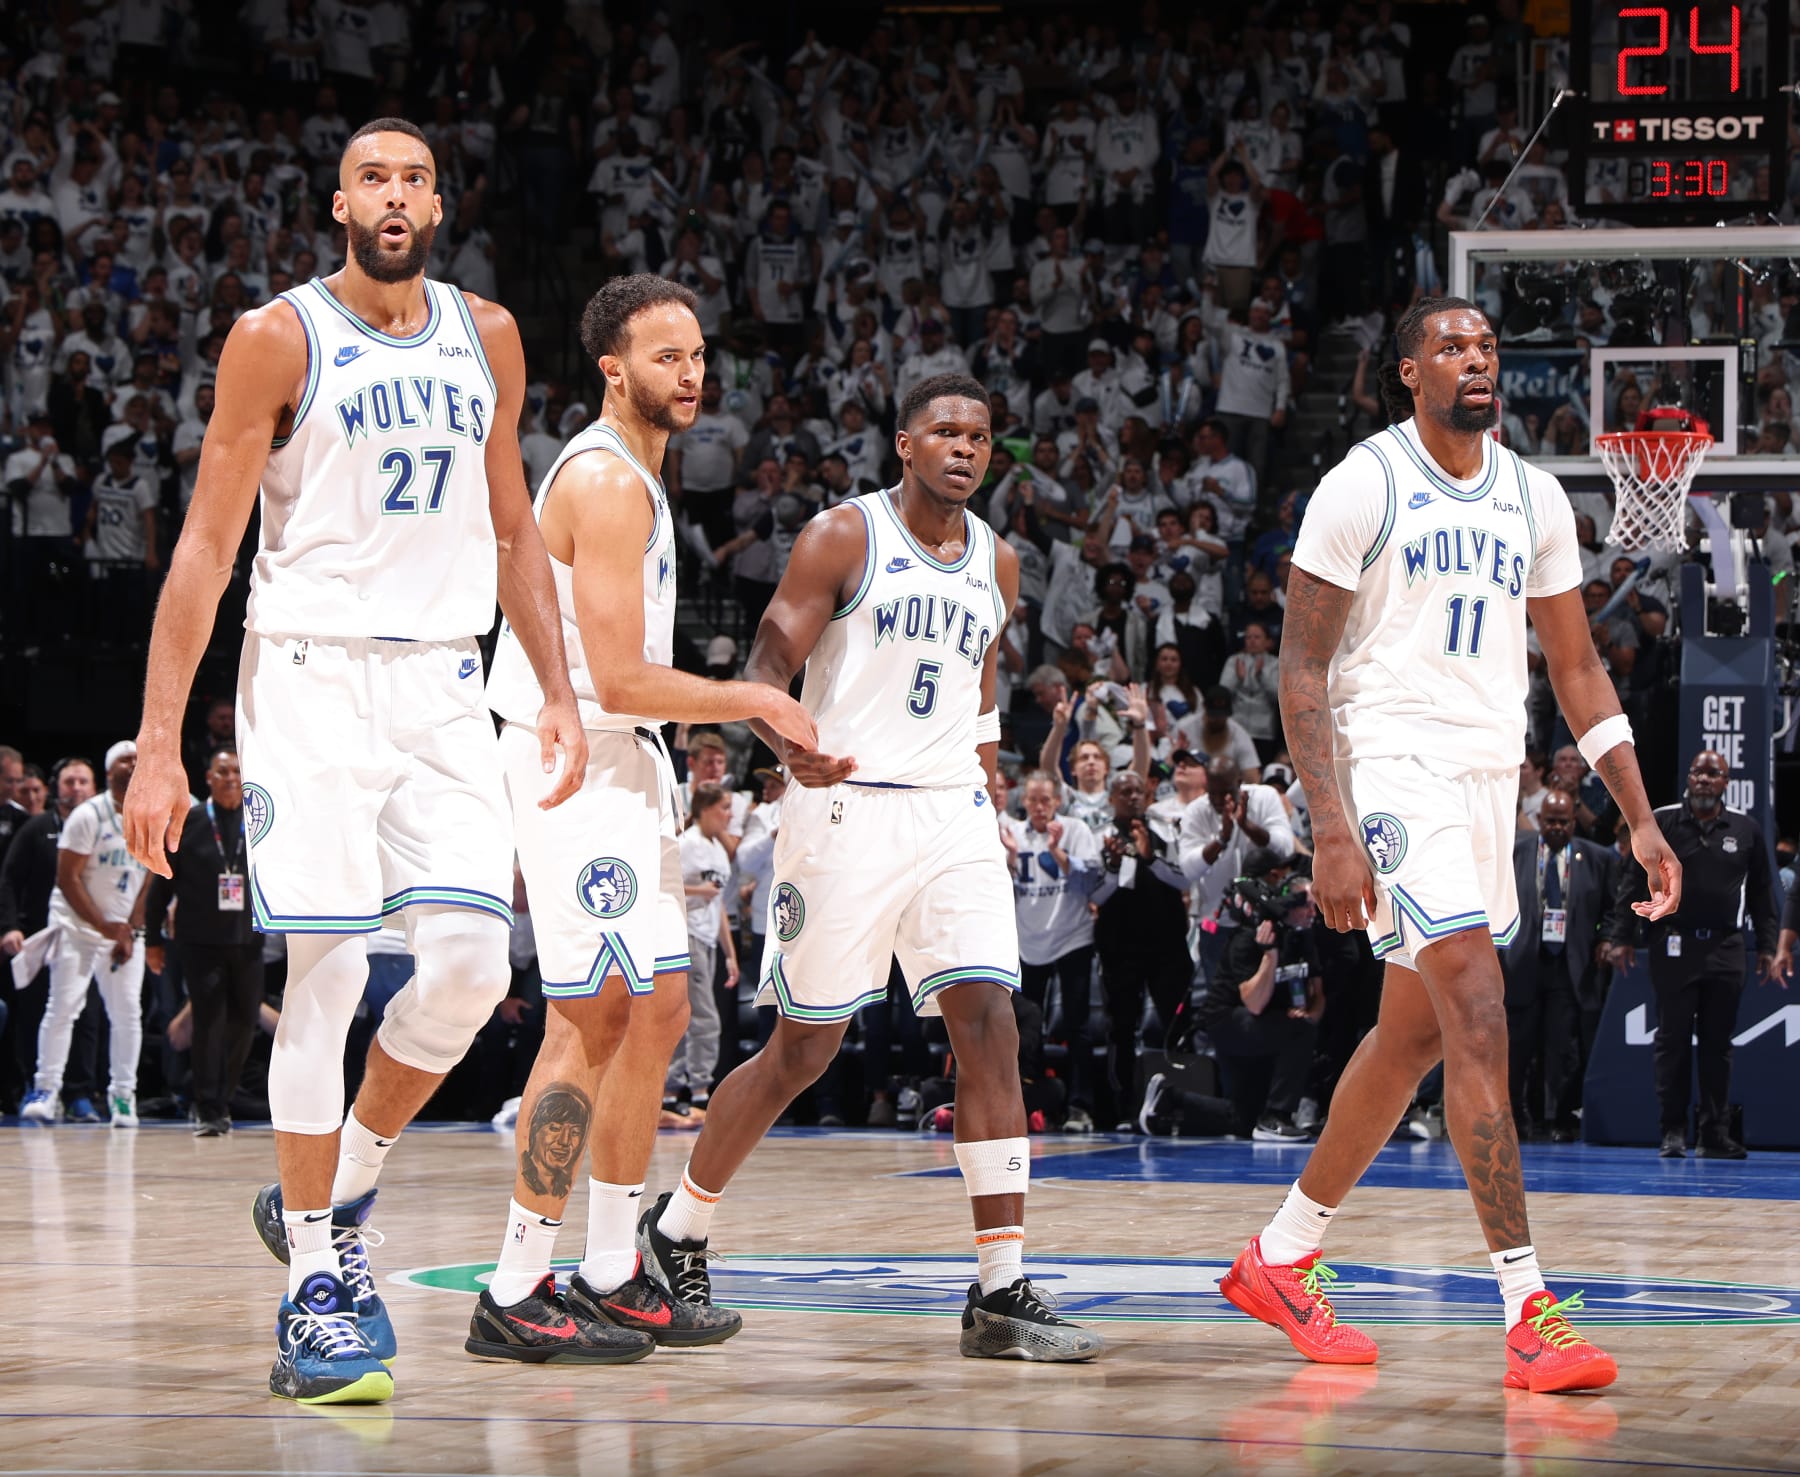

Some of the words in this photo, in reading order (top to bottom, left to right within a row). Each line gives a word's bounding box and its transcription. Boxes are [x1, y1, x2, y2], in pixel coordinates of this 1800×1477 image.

[1617, 5, 1741, 96] 24
[1593, 122, 1609, 139] T
[1640, 116, 1764, 140] TISSOT
[1651, 160, 1729, 197] 3:30
[336, 377, 486, 449] WOLVES
[379, 446, 456, 515] 27
[1401, 526, 1525, 600] WOLVES
[873, 594, 991, 669] WOLVES
[1444, 594, 1488, 658] 11
[906, 659, 943, 719] 5
[1703, 695, 1745, 731] GET
[1702, 734, 1745, 769] THE
[117, 871, 129, 893] 4
[1006, 1157, 1022, 1171] 5
